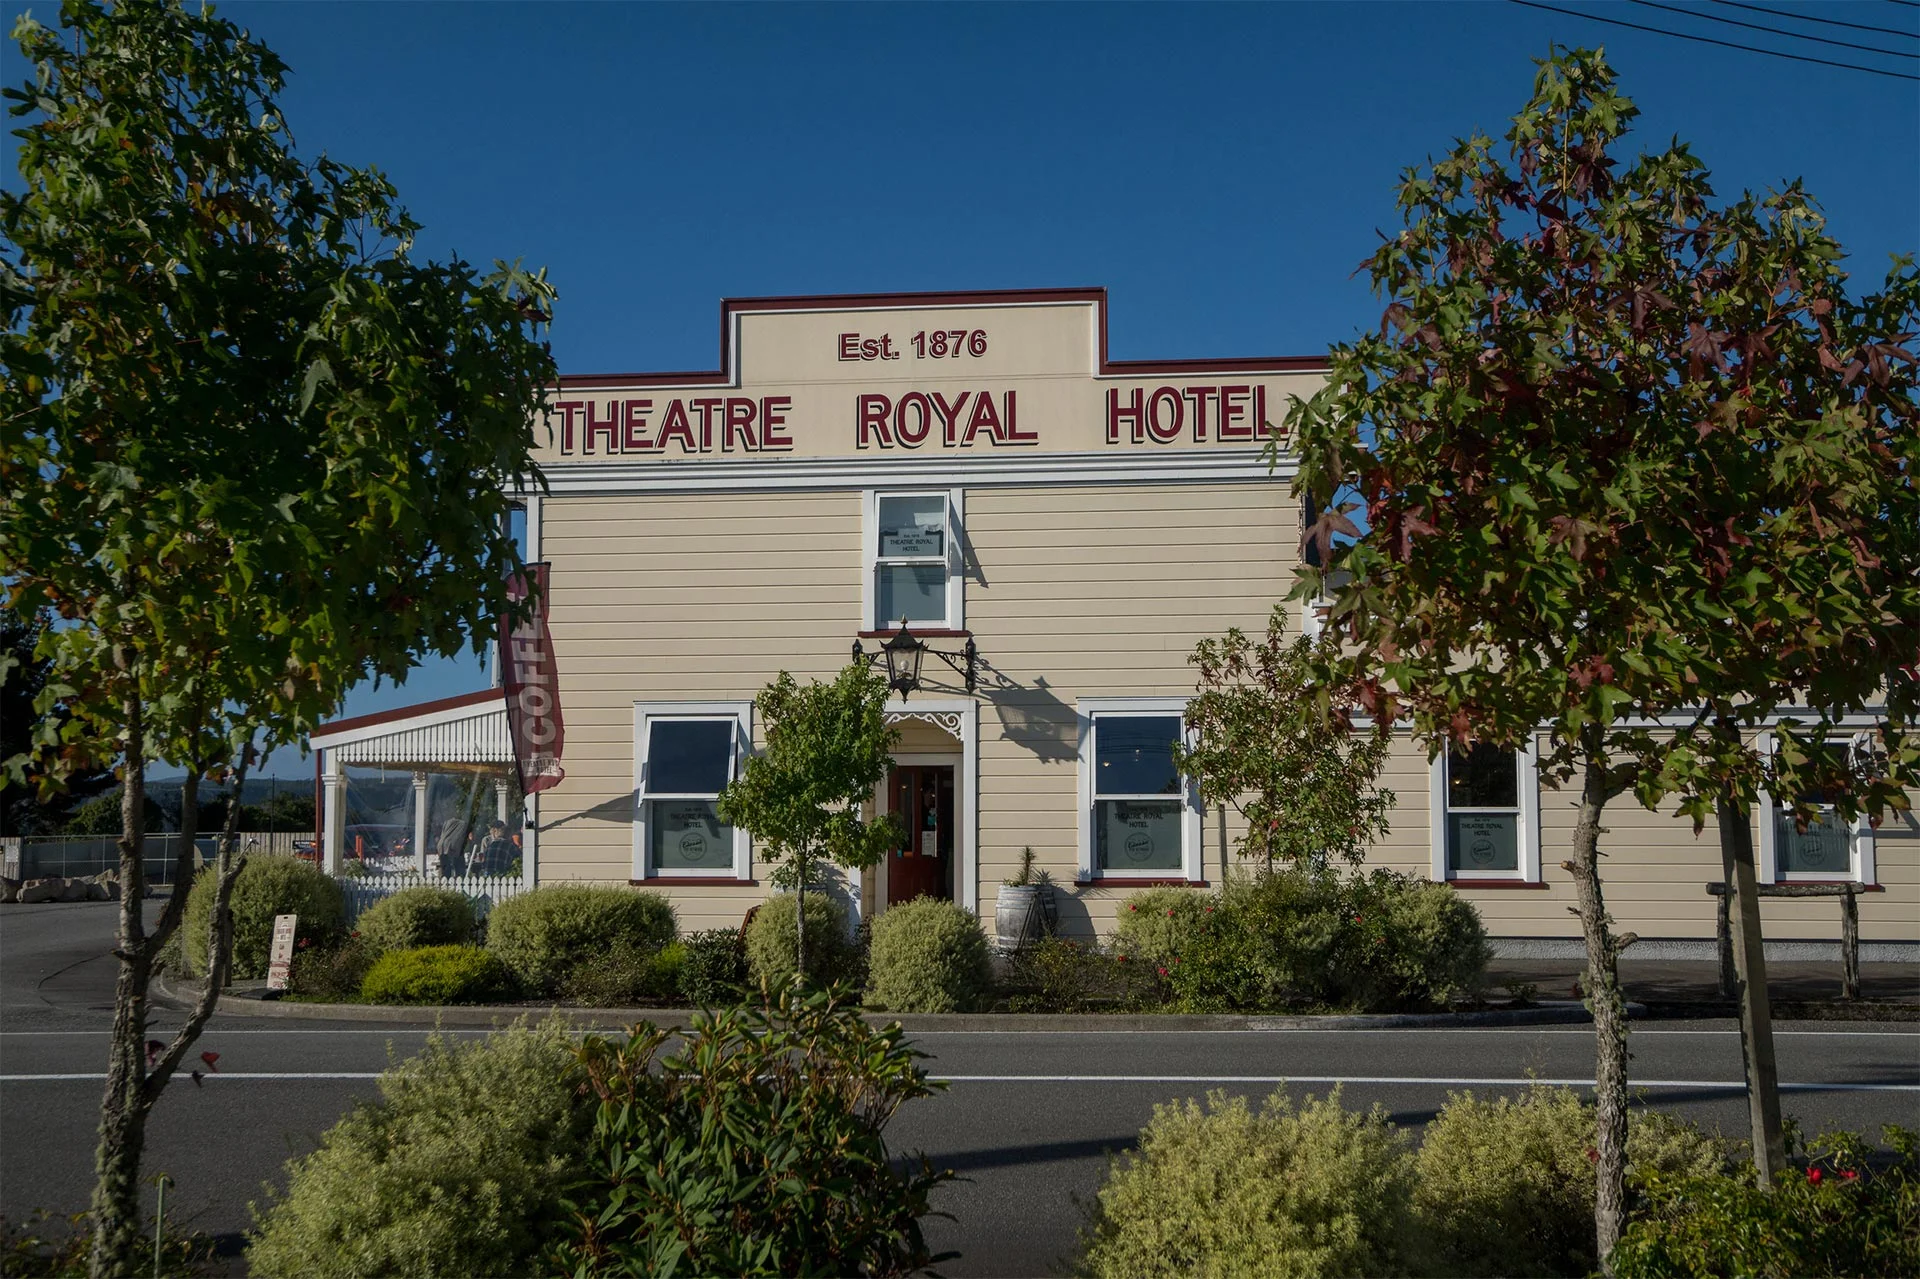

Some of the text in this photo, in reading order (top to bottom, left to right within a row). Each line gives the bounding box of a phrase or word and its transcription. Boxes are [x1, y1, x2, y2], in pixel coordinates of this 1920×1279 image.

[839, 329, 987, 361] Est. 1876
[551, 385, 1289, 456] THEATRE ROYAL HOTEL
[507, 592, 557, 745] COFFE
